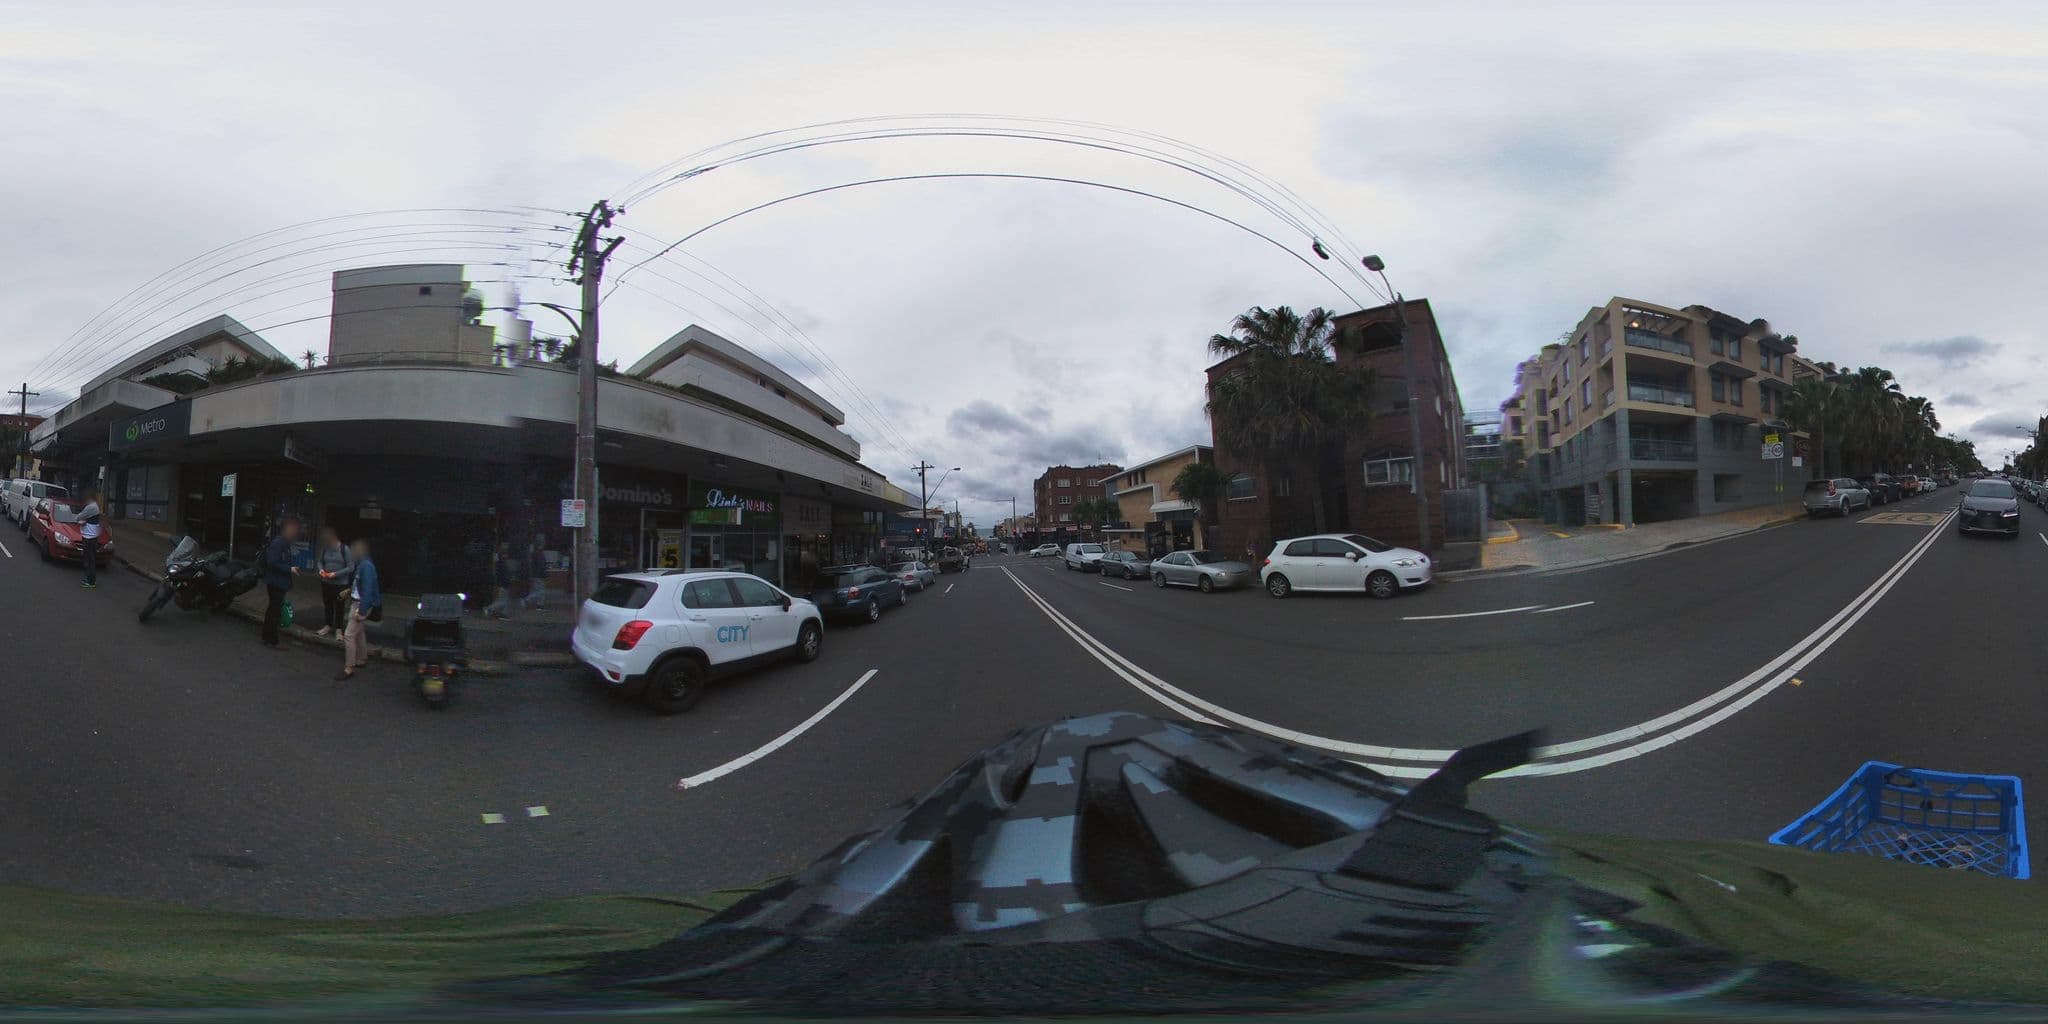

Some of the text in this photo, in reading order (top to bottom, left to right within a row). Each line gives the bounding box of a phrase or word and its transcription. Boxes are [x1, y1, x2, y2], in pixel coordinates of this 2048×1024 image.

[140, 418, 166, 435] Metro
[745, 498, 775, 512] NAILS
[717, 625, 750, 643] CITY
